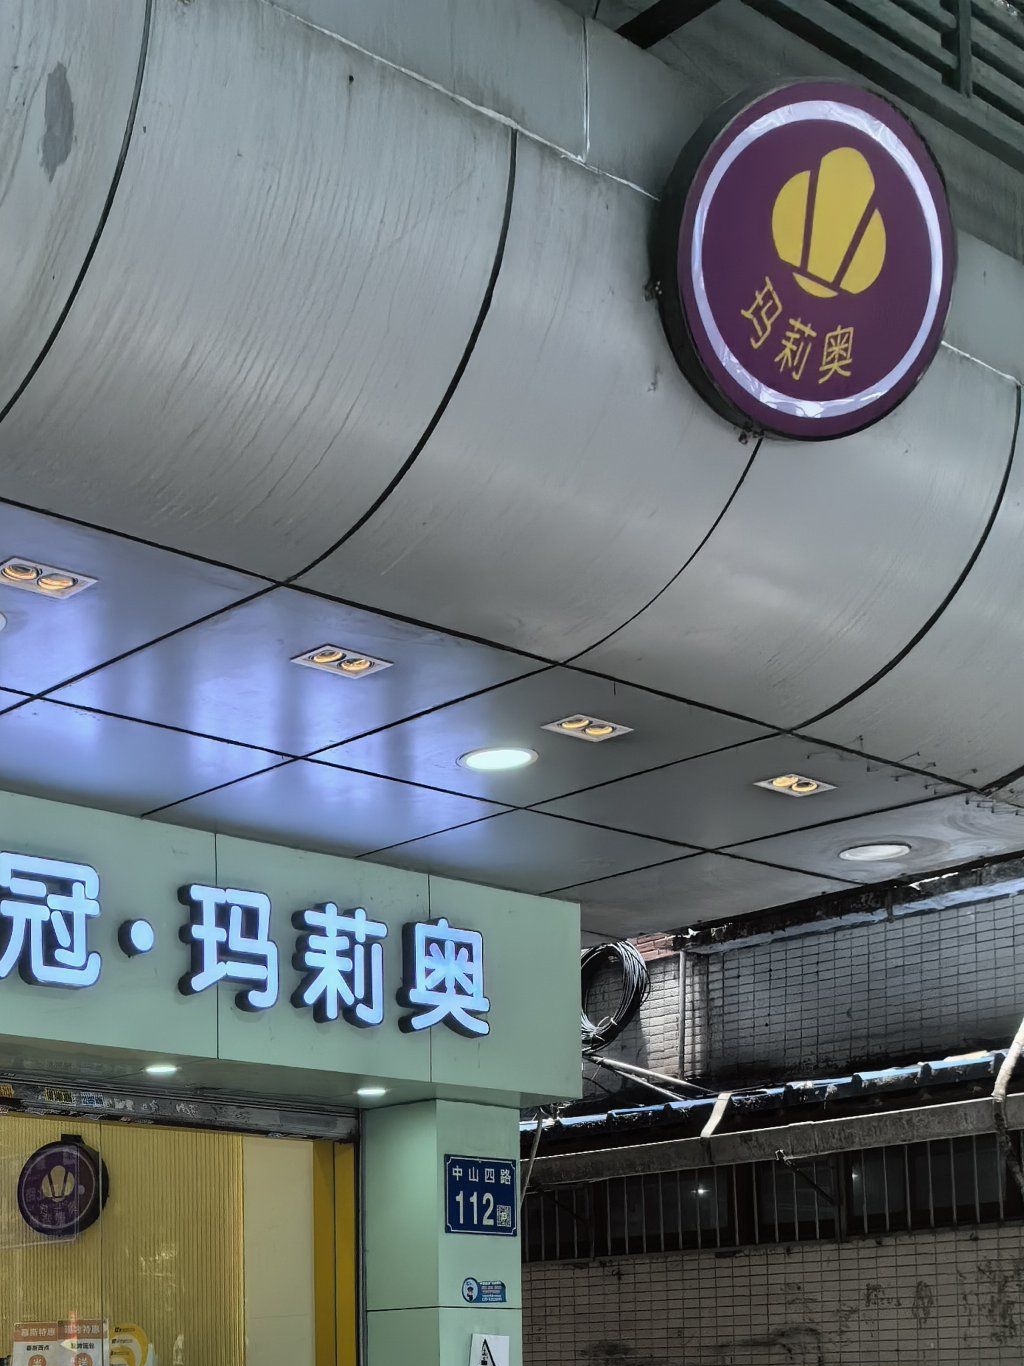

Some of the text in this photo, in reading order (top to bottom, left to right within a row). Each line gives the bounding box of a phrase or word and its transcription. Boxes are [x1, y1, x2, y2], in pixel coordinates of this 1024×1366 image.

[741, 276, 854, 384] 玛莉奥
[452, 1165, 511, 1185] 中山四路
[455, 1191, 494, 1226] 112
